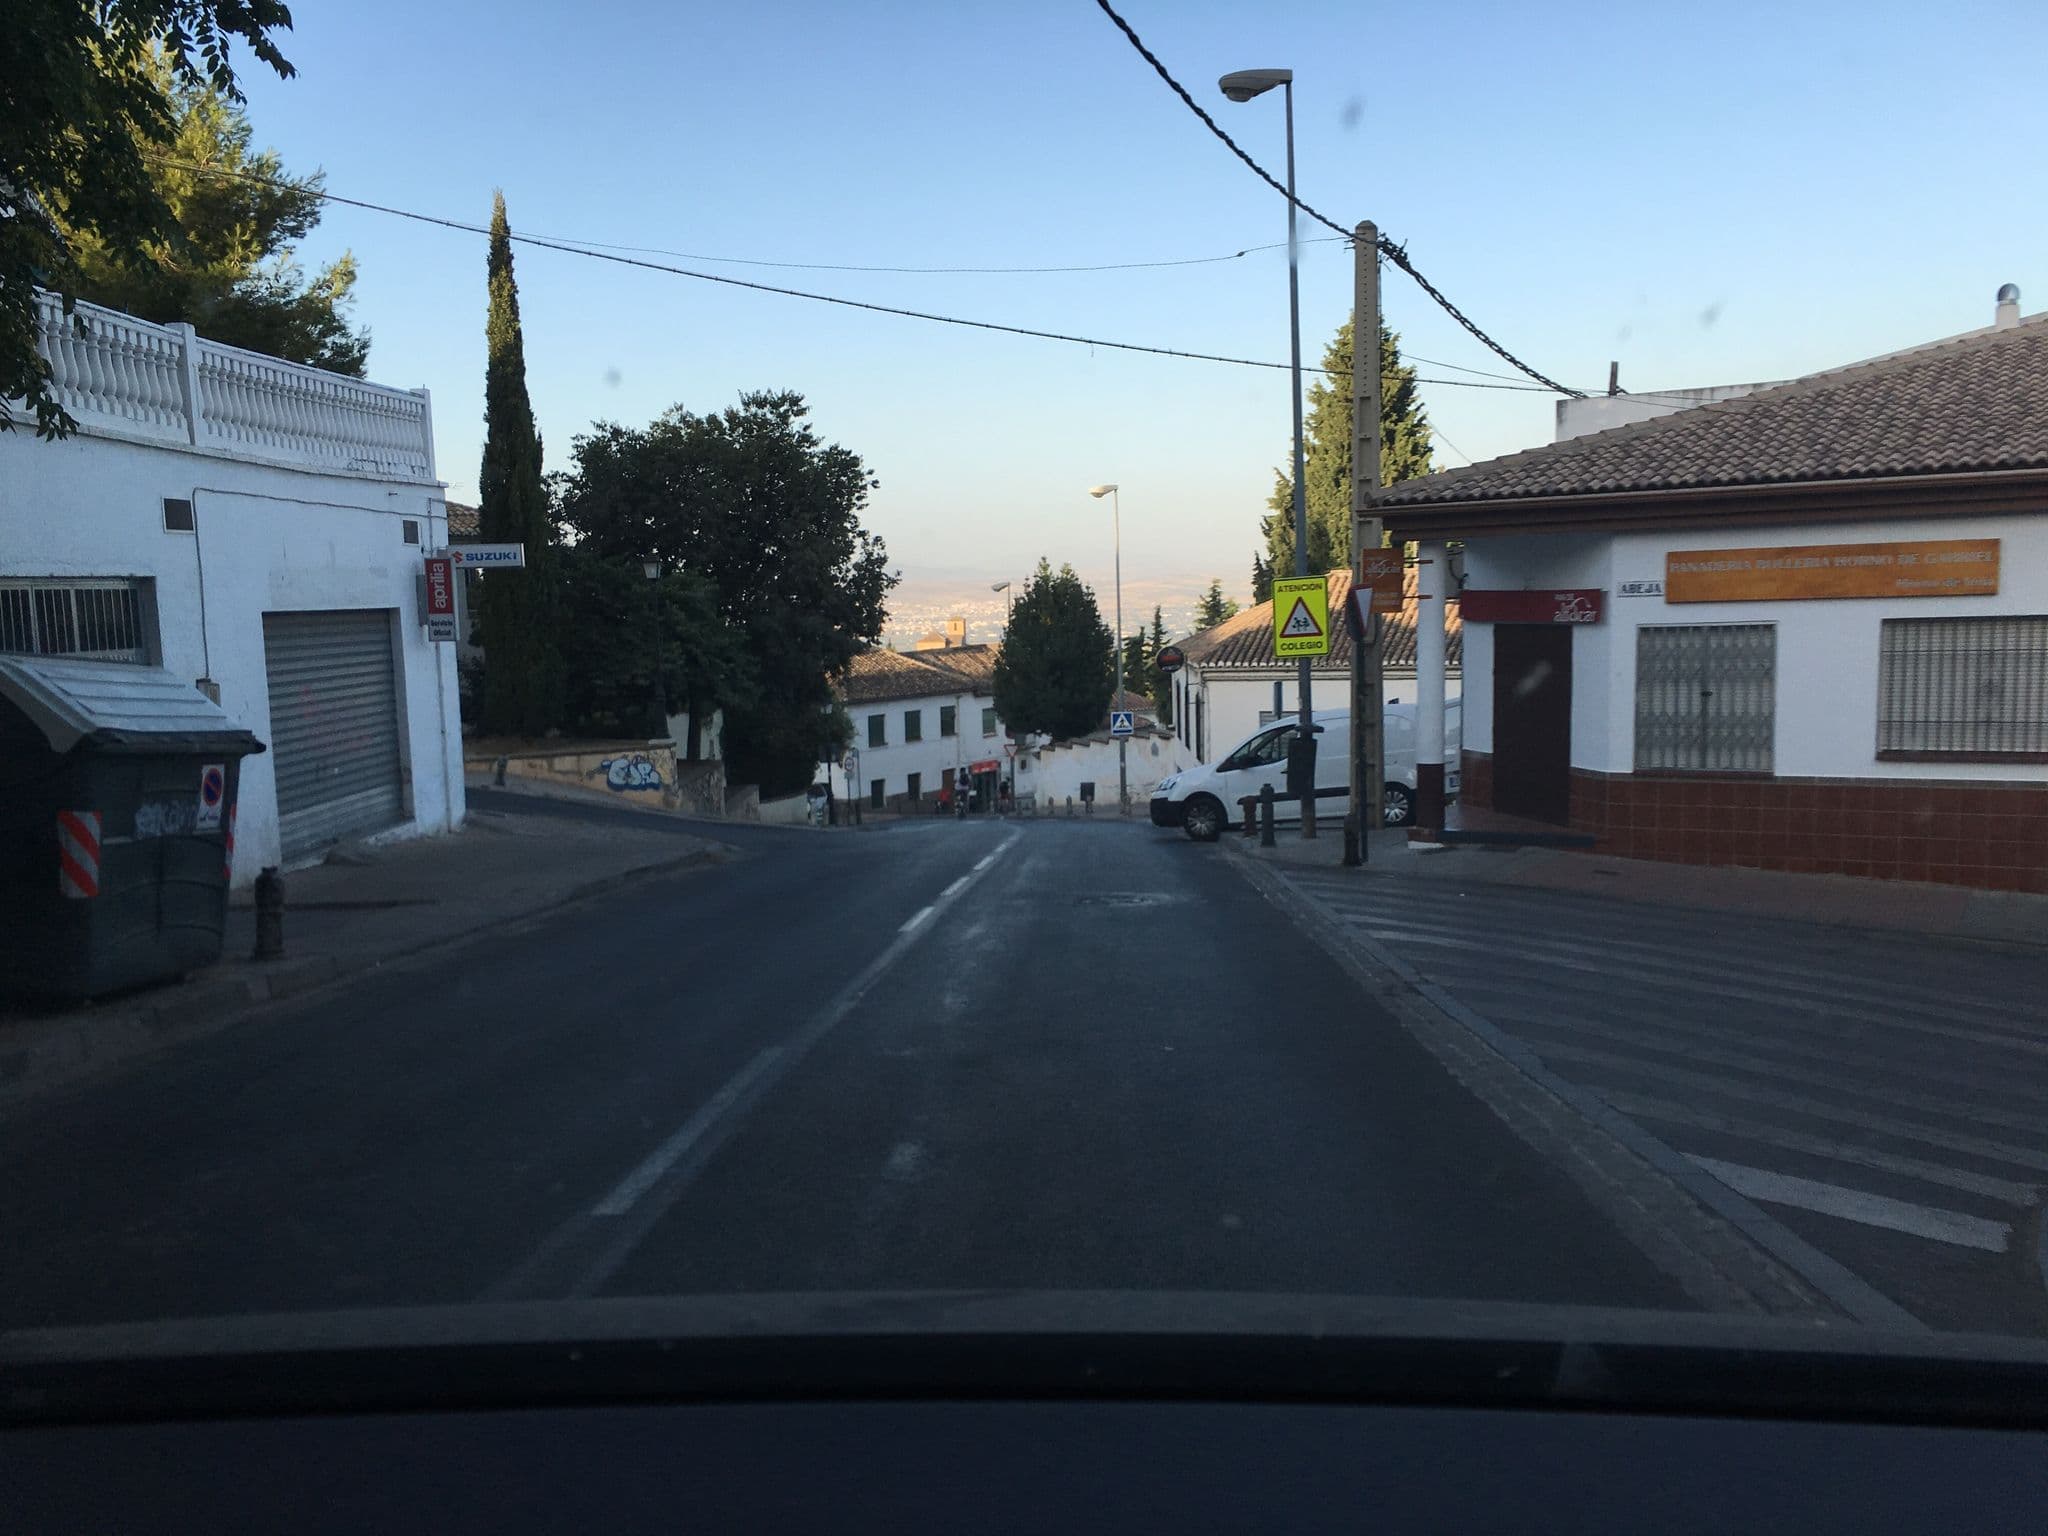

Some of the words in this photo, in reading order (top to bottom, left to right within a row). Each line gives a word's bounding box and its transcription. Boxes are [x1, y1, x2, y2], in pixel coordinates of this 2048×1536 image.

[466, 552, 517, 561] SUZUKI
[430, 563, 448, 608] aprilia
[1621, 583, 1662, 594] ABEJA
[1280, 640, 1323, 651] COLEGIO
